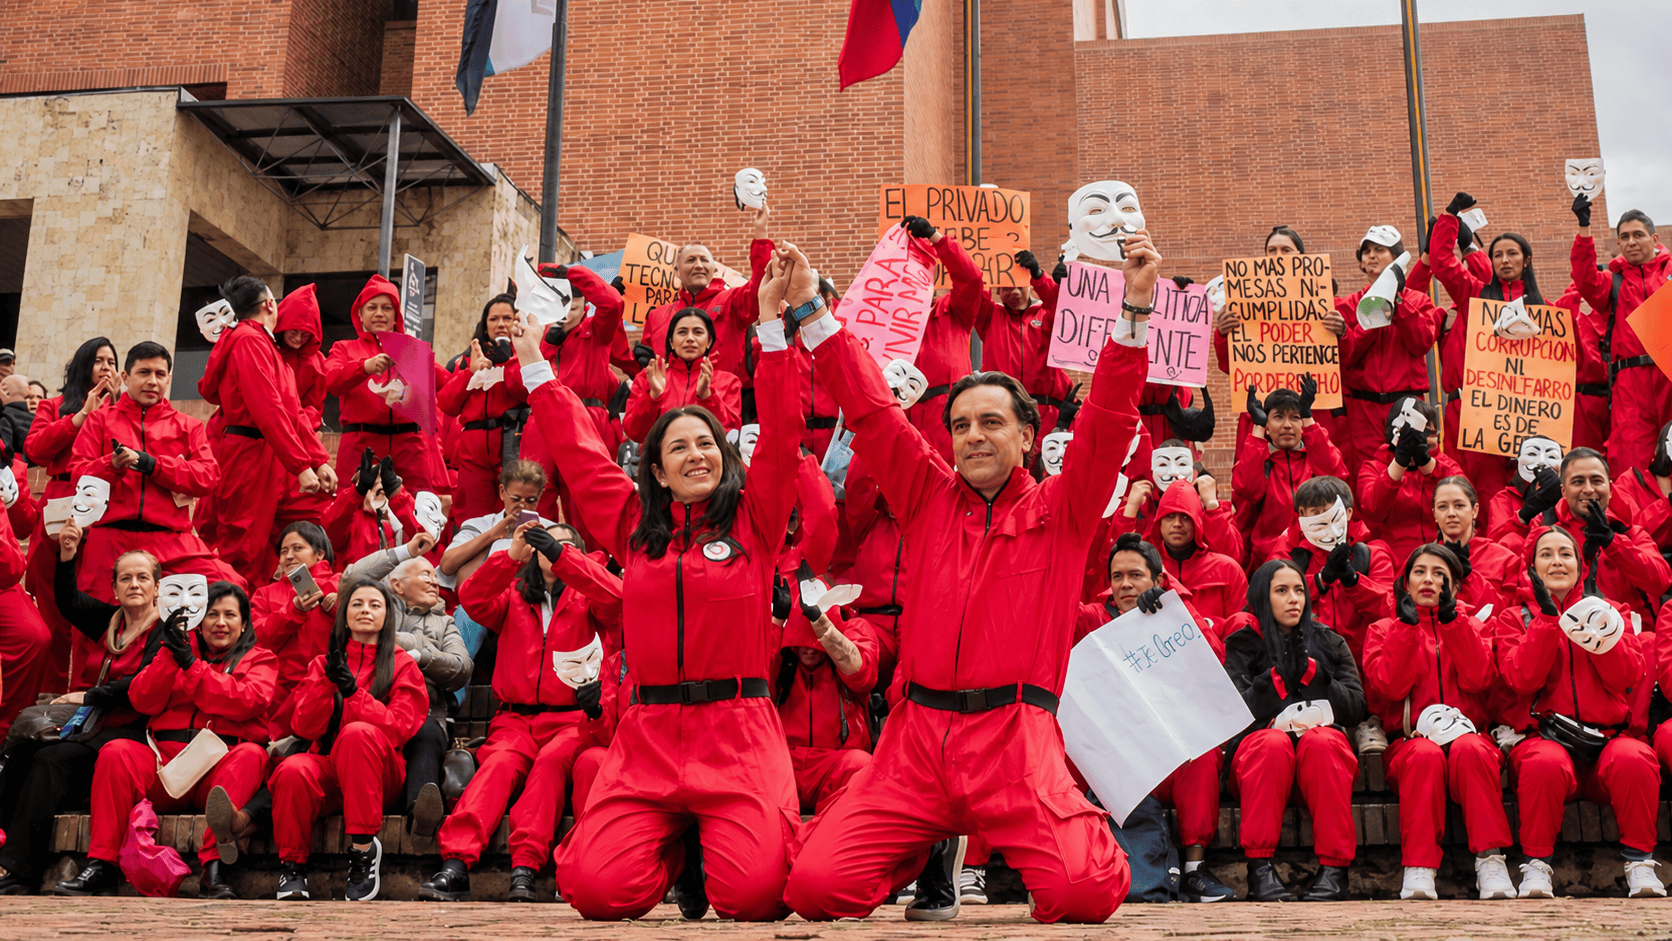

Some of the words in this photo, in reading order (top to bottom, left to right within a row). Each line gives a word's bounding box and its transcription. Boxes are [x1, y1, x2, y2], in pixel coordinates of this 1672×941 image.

[927, 187, 1024, 224] PRIVADO
[647, 241, 677, 266] QU
[1225, 260, 1248, 278] NO
[1254, 257, 1285, 277] MAS
[1292, 256, 1330, 277] PRO-
[856, 258, 908, 327] PARA
[1067, 265, 1110, 304] UNA
[1227, 278, 1287, 298] MESAS
[1229, 299, 1328, 321] CUMPLIDAS
[1528, 306, 1567, 338] MAS
[882, 307, 923, 360] IVIR
[1057, 308, 1202, 370] DIFENTE
[1232, 322, 1252, 342] EL
[1260, 322, 1315, 343] PODER
[1232, 344, 1266, 363] NOS
[1476, 331, 1576, 362] CORRUPCION
[1471, 390, 1493, 408] EL
[1497, 394, 1562, 420] DINERO
[1494, 414, 1511, 431] ES
[1516, 416, 1540, 435] DE
[1462, 428, 1484, 450] LA
